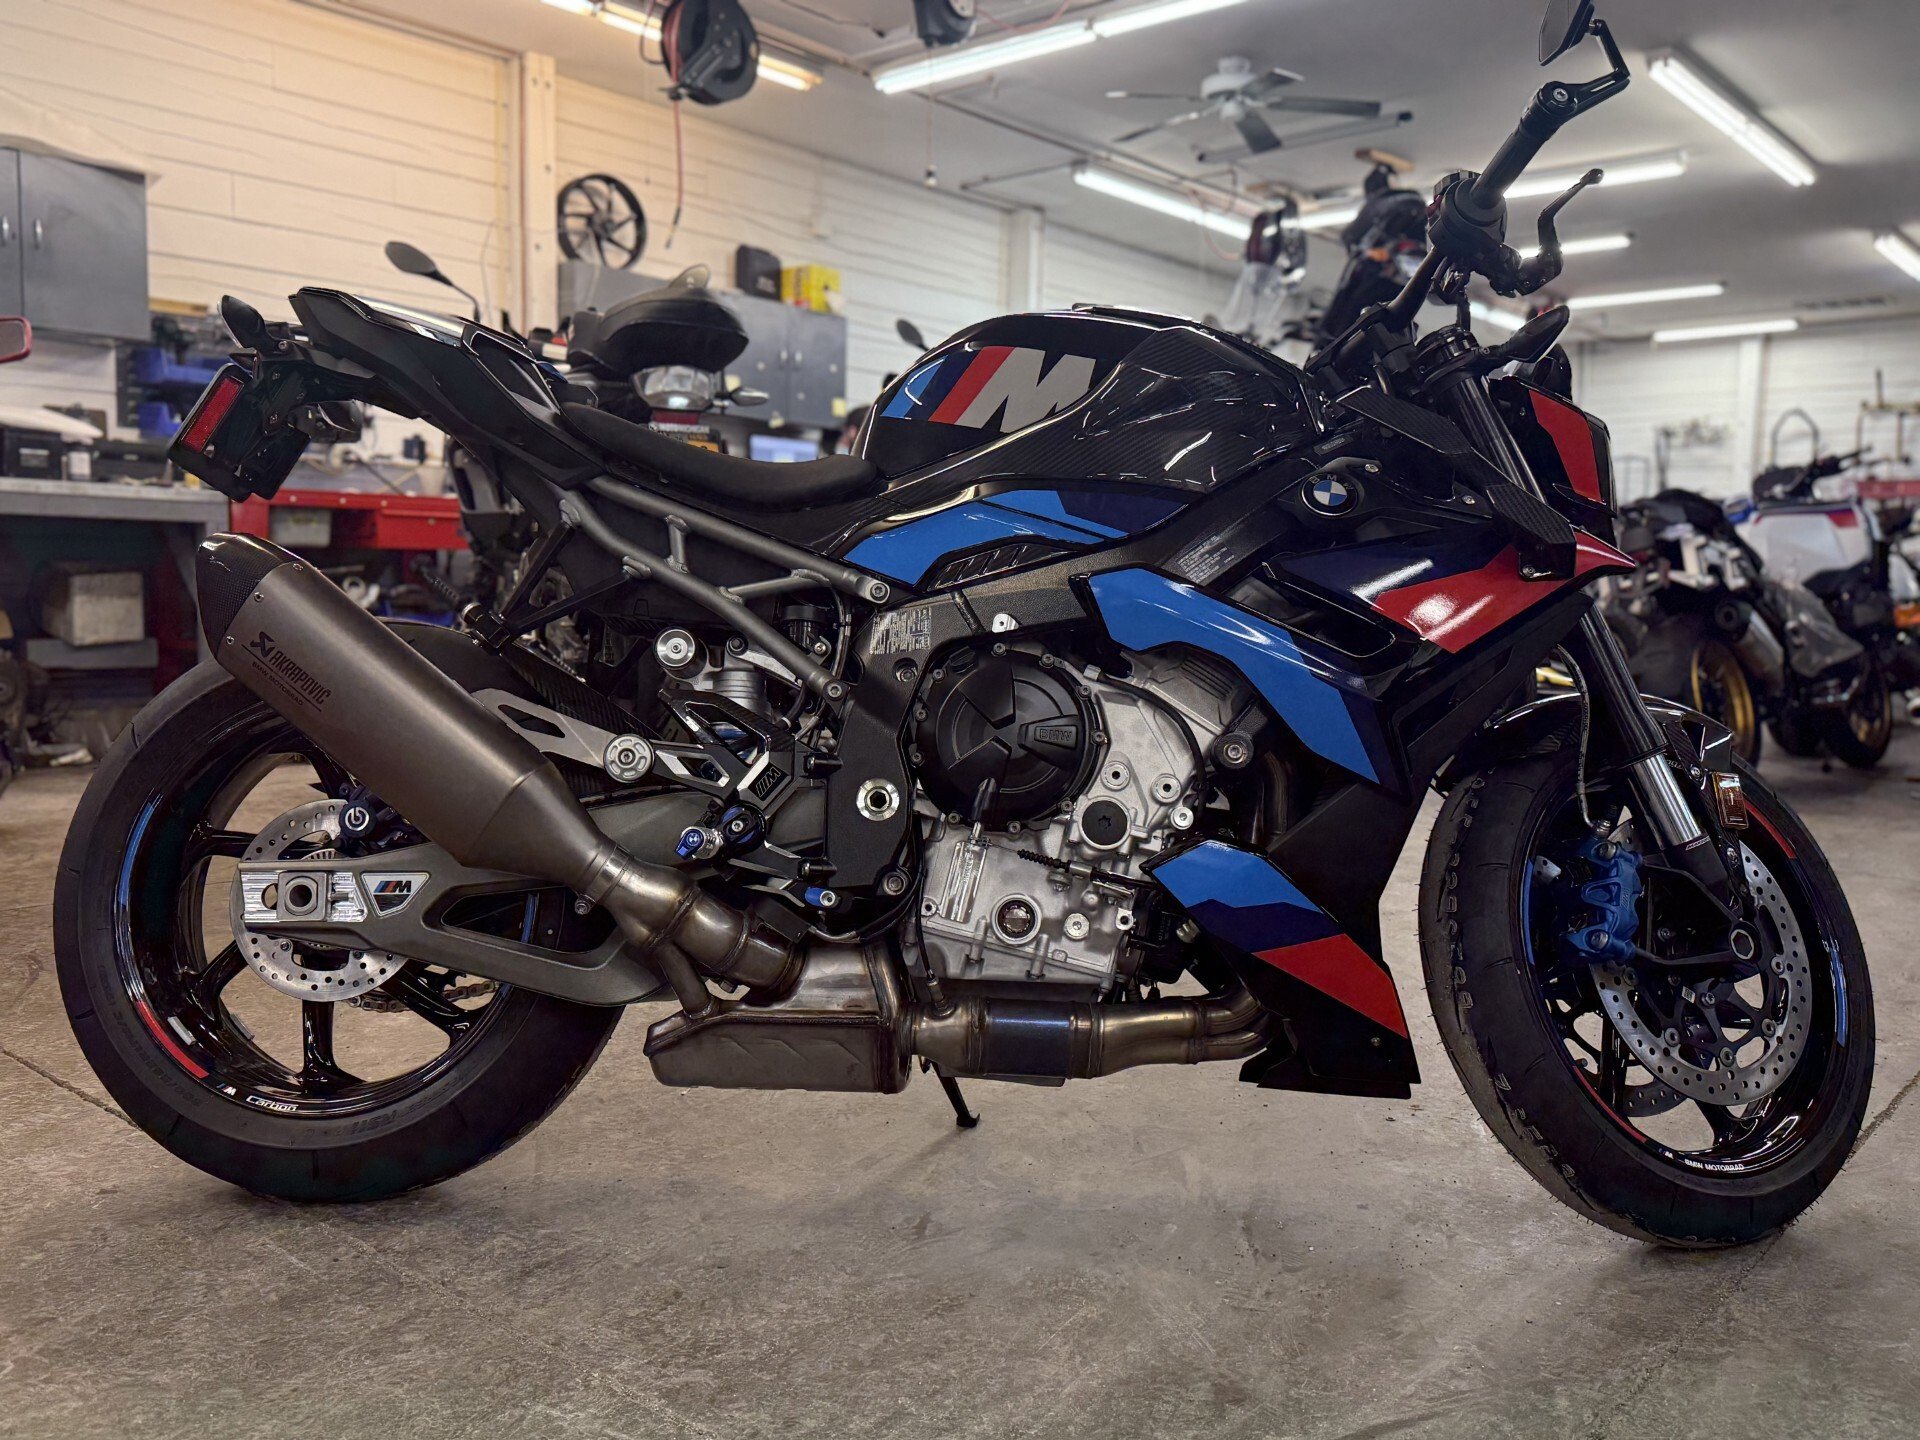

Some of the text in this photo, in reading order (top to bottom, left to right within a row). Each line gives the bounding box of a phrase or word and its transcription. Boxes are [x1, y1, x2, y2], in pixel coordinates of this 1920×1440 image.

[252, 661, 304, 706] BMW MOTORRAD
[1039, 728, 1073, 742] BMW
[390, 880, 412, 893] M
[246, 1094, 300, 1113] Carbon
[1684, 1158, 1745, 1173] BMW MOTORRAD
